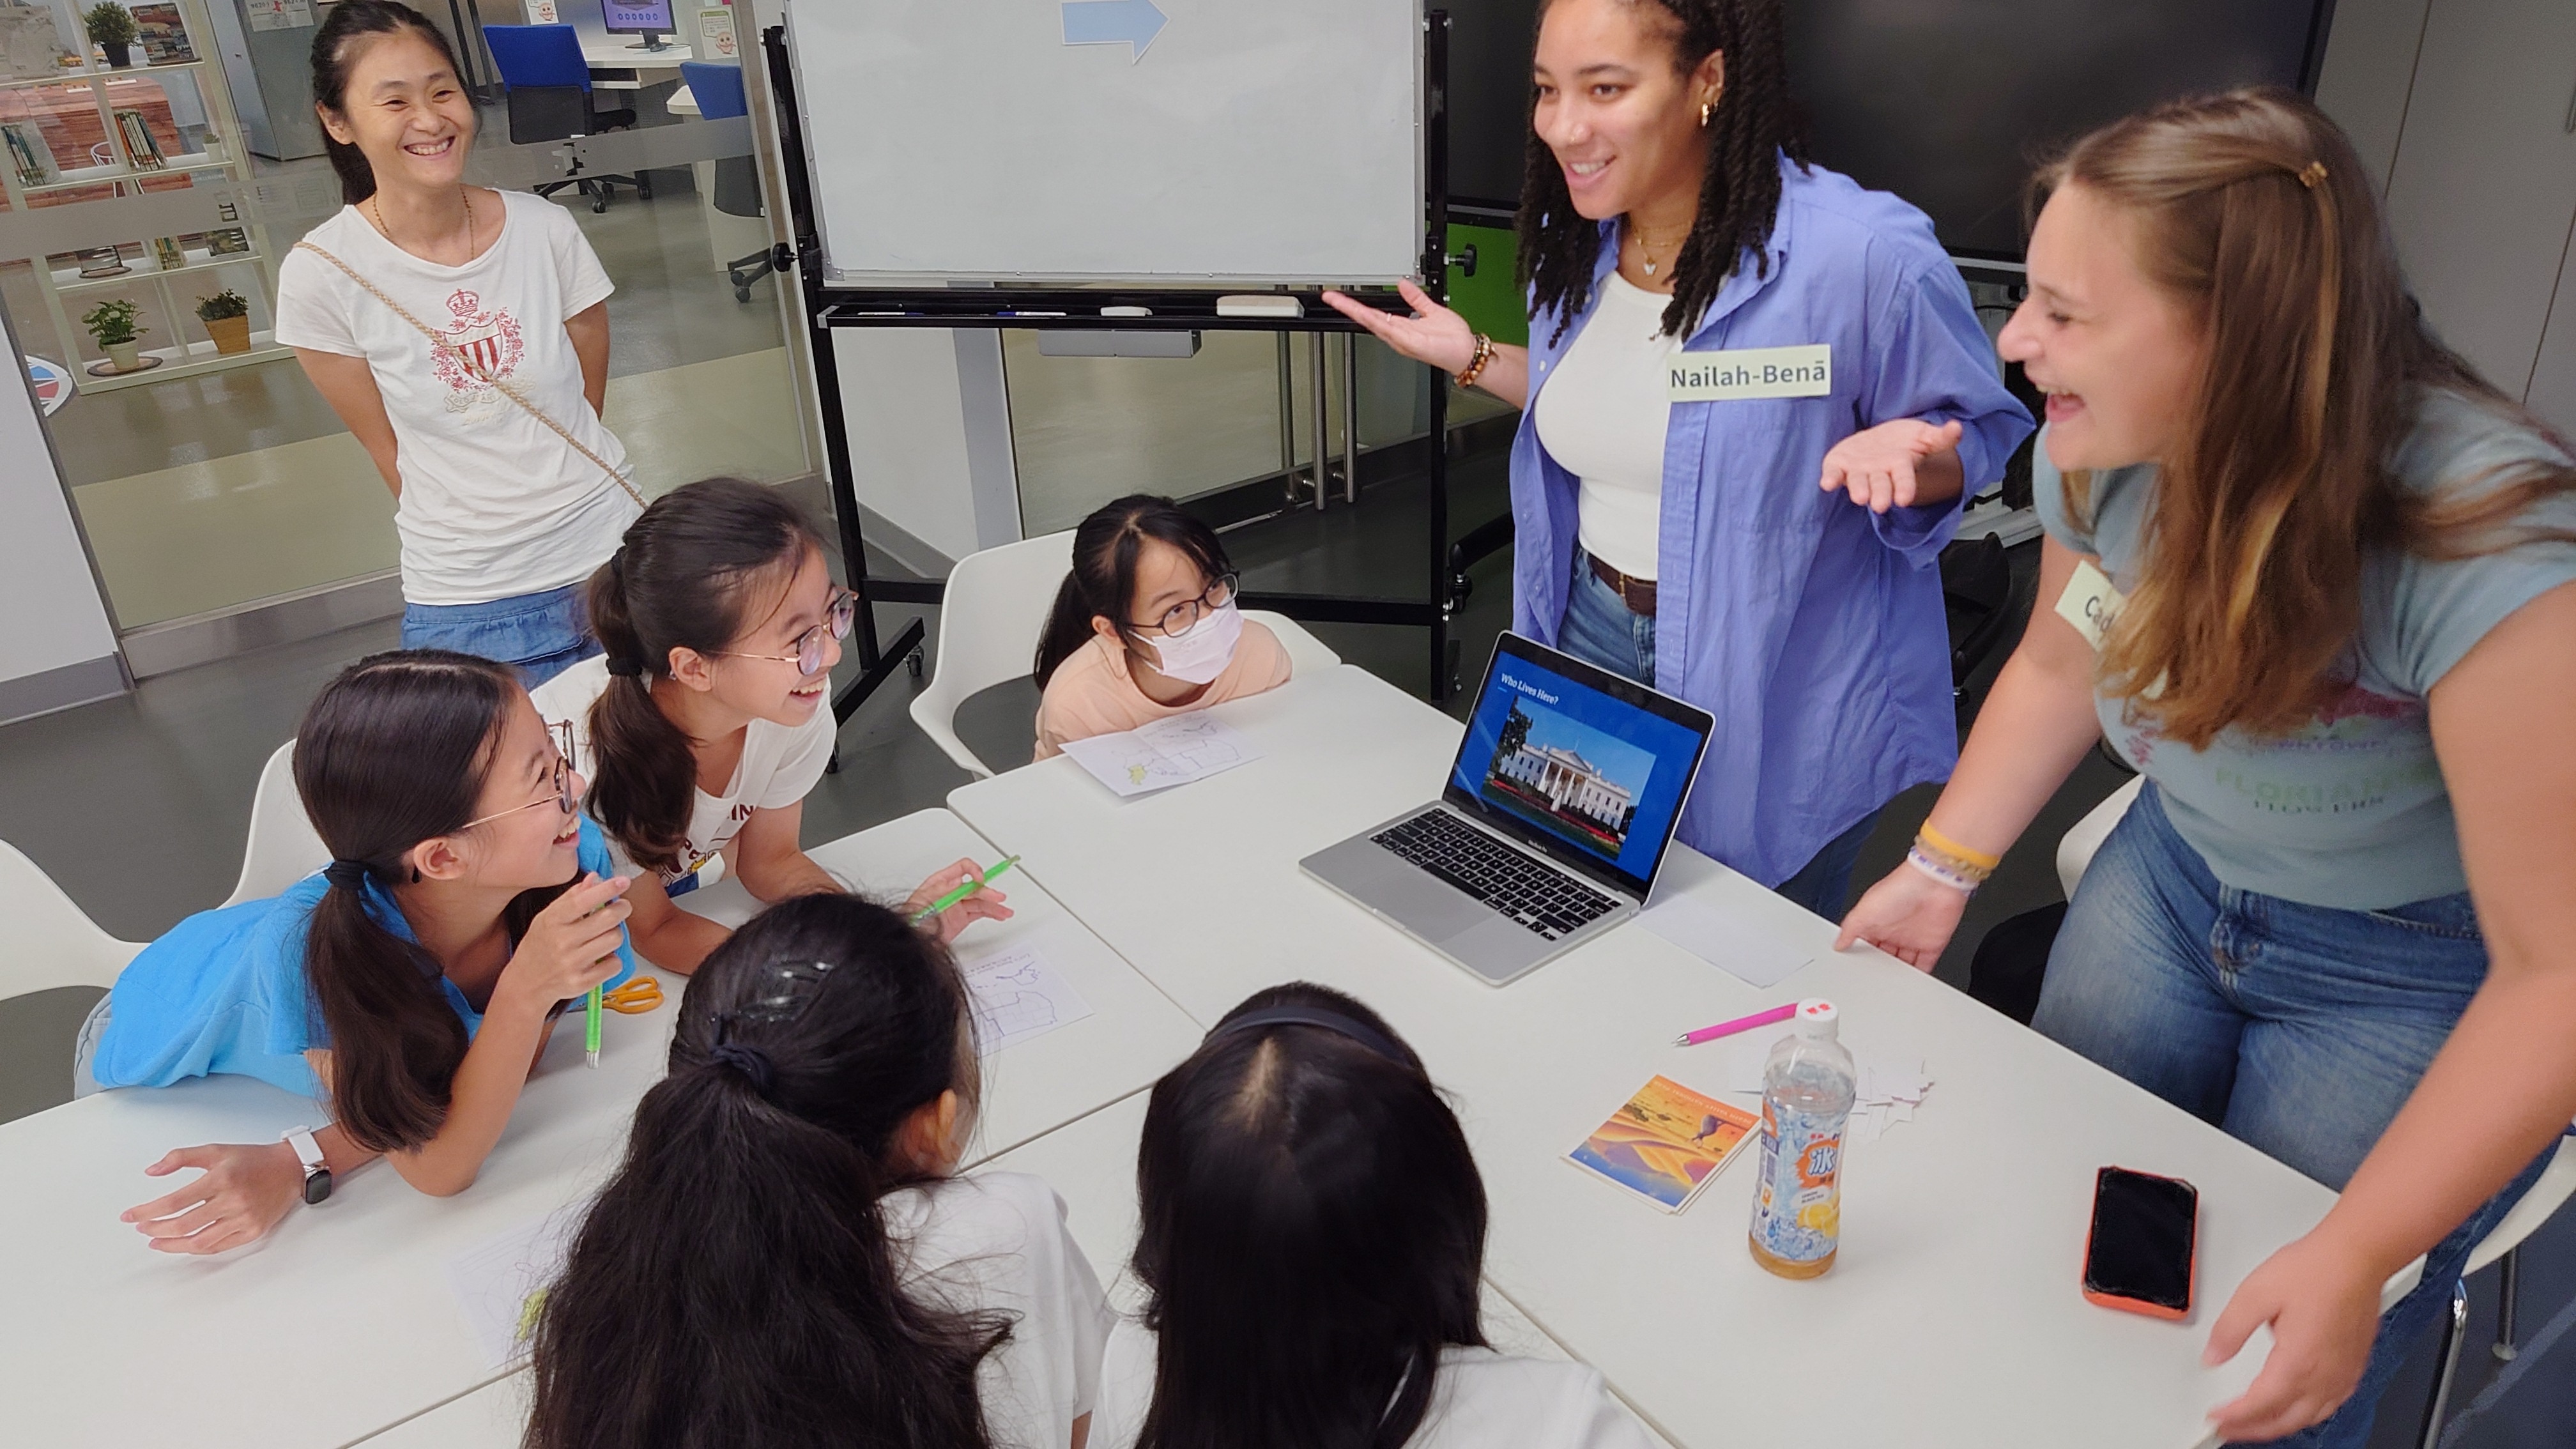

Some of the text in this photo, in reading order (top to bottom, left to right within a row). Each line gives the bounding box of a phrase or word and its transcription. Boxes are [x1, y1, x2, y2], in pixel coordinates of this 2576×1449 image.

[1671, 360, 1826, 388] Nailah-Benā
[1501, 673, 1559, 705] Who Lives Here?
